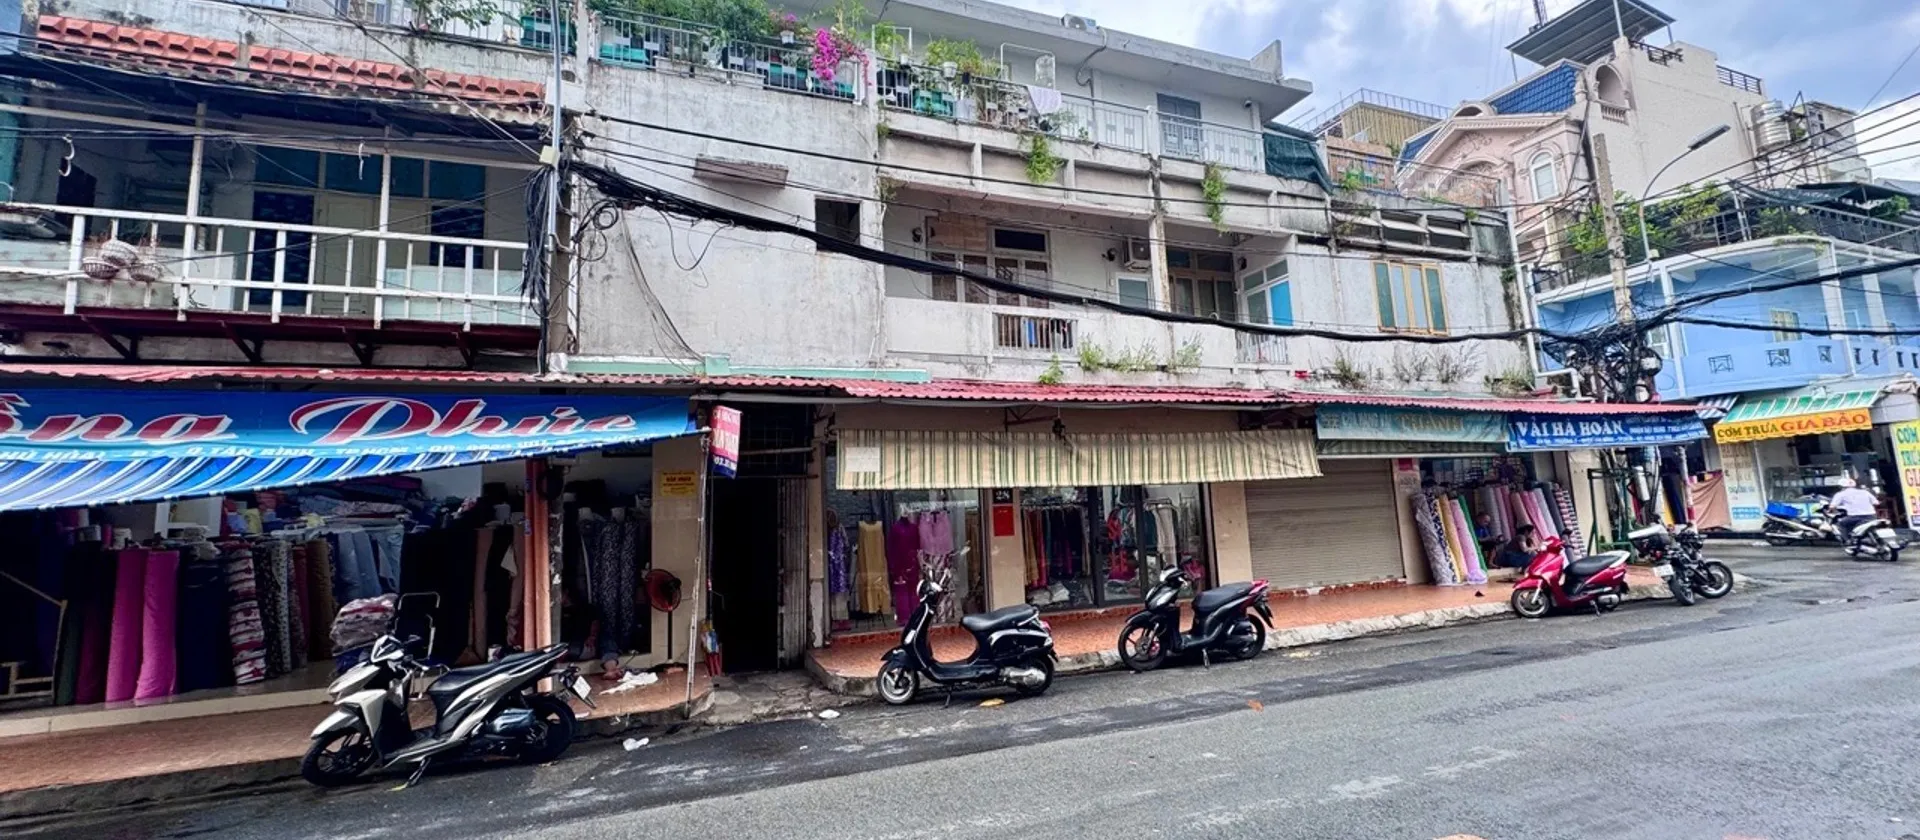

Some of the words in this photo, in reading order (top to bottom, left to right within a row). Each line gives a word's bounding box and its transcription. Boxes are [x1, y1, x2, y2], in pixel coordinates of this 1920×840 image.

[1717, 426, 1741, 438] CƠM
[1743, 421, 1779, 435] TRƯA
[1781, 419, 1820, 432] GIA
[1822, 412, 1868, 427] BẢO
